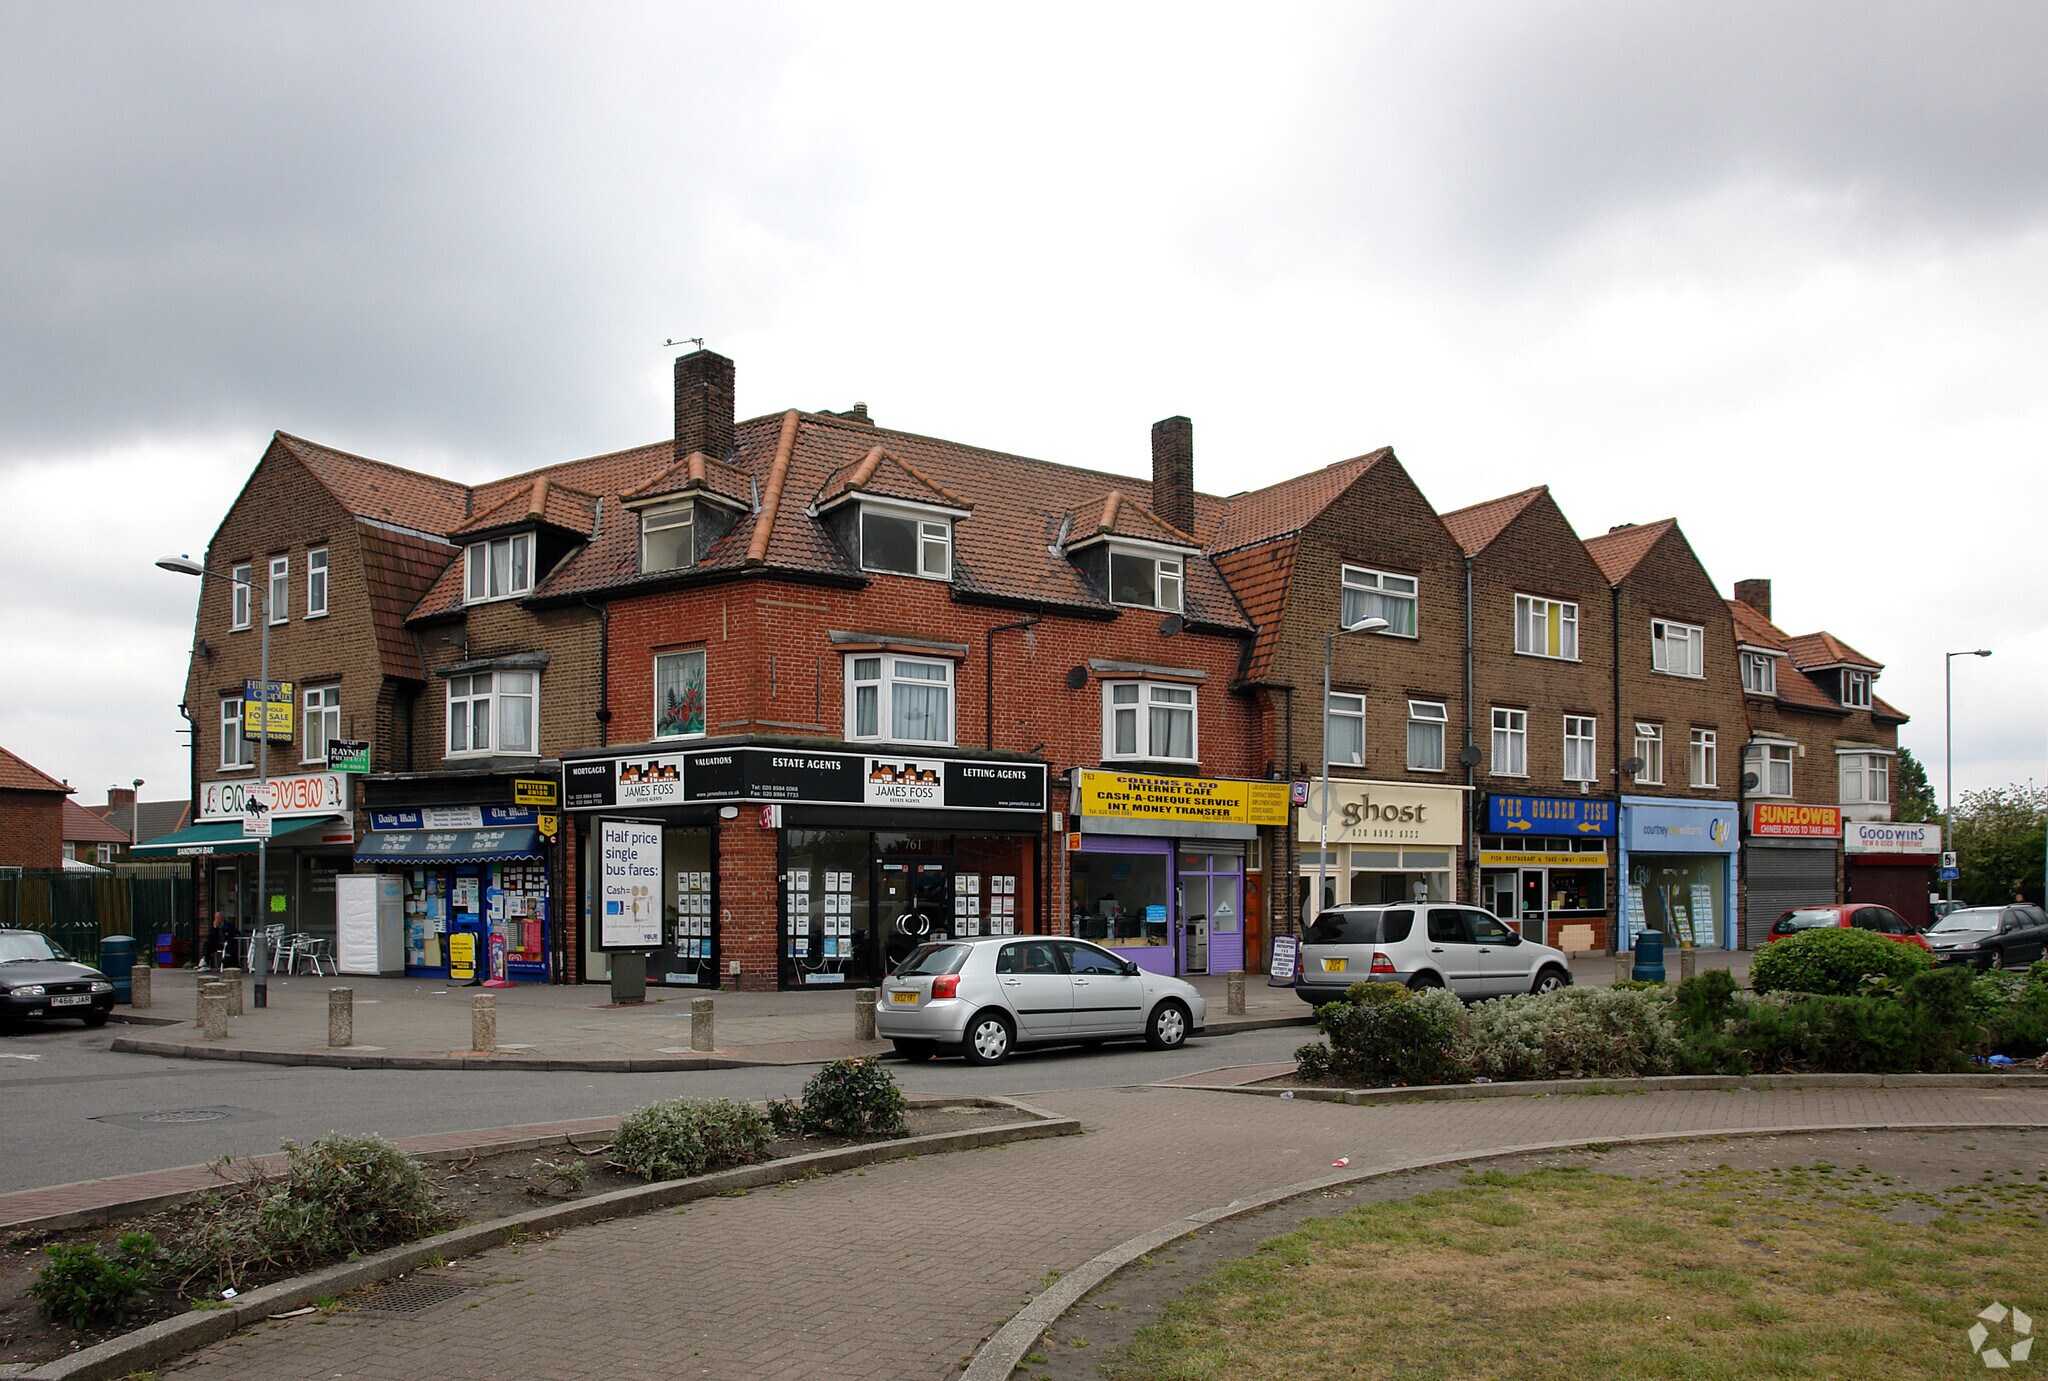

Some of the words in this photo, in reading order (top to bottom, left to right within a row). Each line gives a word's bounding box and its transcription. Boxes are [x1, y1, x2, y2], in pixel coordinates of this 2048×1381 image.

[331, 748, 366, 756] RAYNER
[695, 756, 732, 766] VALUATIONS
[772, 758, 804, 768] ESTATE
[807, 760, 841, 770] AGENTS
[573, 766, 606, 775] MORTGAGES
[963, 768, 995, 778] LETTING
[997, 770, 1026, 779] AGENTS
[1117, 777, 1179, 787] COLLINS
[625, 786, 650, 798] JAMES
[653, 784, 674, 796] FOSS
[875, 786, 906, 798] JAMES
[910, 788, 933, 798] FOSS
[1128, 784, 1182, 794] INTERNET
[1186, 787, 1212, 796] CAFE
[1097, 792, 1191, 805] CASH-A-CHEQUE
[1194, 799, 1240, 807] SERVICE
[491, 808, 506, 818] The
[508, 807, 528, 816] Mail
[1108, 803, 1130, 811] INT.
[1132, 804, 1172, 813] MONEY
[1175, 807, 1230, 816] TRANSFER
[1341, 792, 1428, 826] ghost
[1499, 799, 1522, 817] THE
[1532, 800, 1575, 819] GOLDEN
[1584, 803, 1608, 820] FISH
[378, 814, 398, 826] Daily
[399, 813, 417, 822] Mail
[1760, 806, 1836, 825] SUNFLOWER
[1352, 829, 1367, 837] 020
[1761, 825, 1781, 833] CHINESE
[1783, 826, 1800, 834] FOODS
[1801, 826, 1808, 834] TO
[1860, 826, 1925, 840] GOODWINS
[384, 834, 398, 843] Daily
[428, 834, 443, 843] Daily
[474, 832, 490, 841] Daily
[606, 830, 629, 842] Half
[632, 832, 657, 846] price
[904, 839, 921, 850] 761
[606, 847, 638, 862] single
[606, 863, 625, 876] bus
[629, 864, 658, 876] fares:
